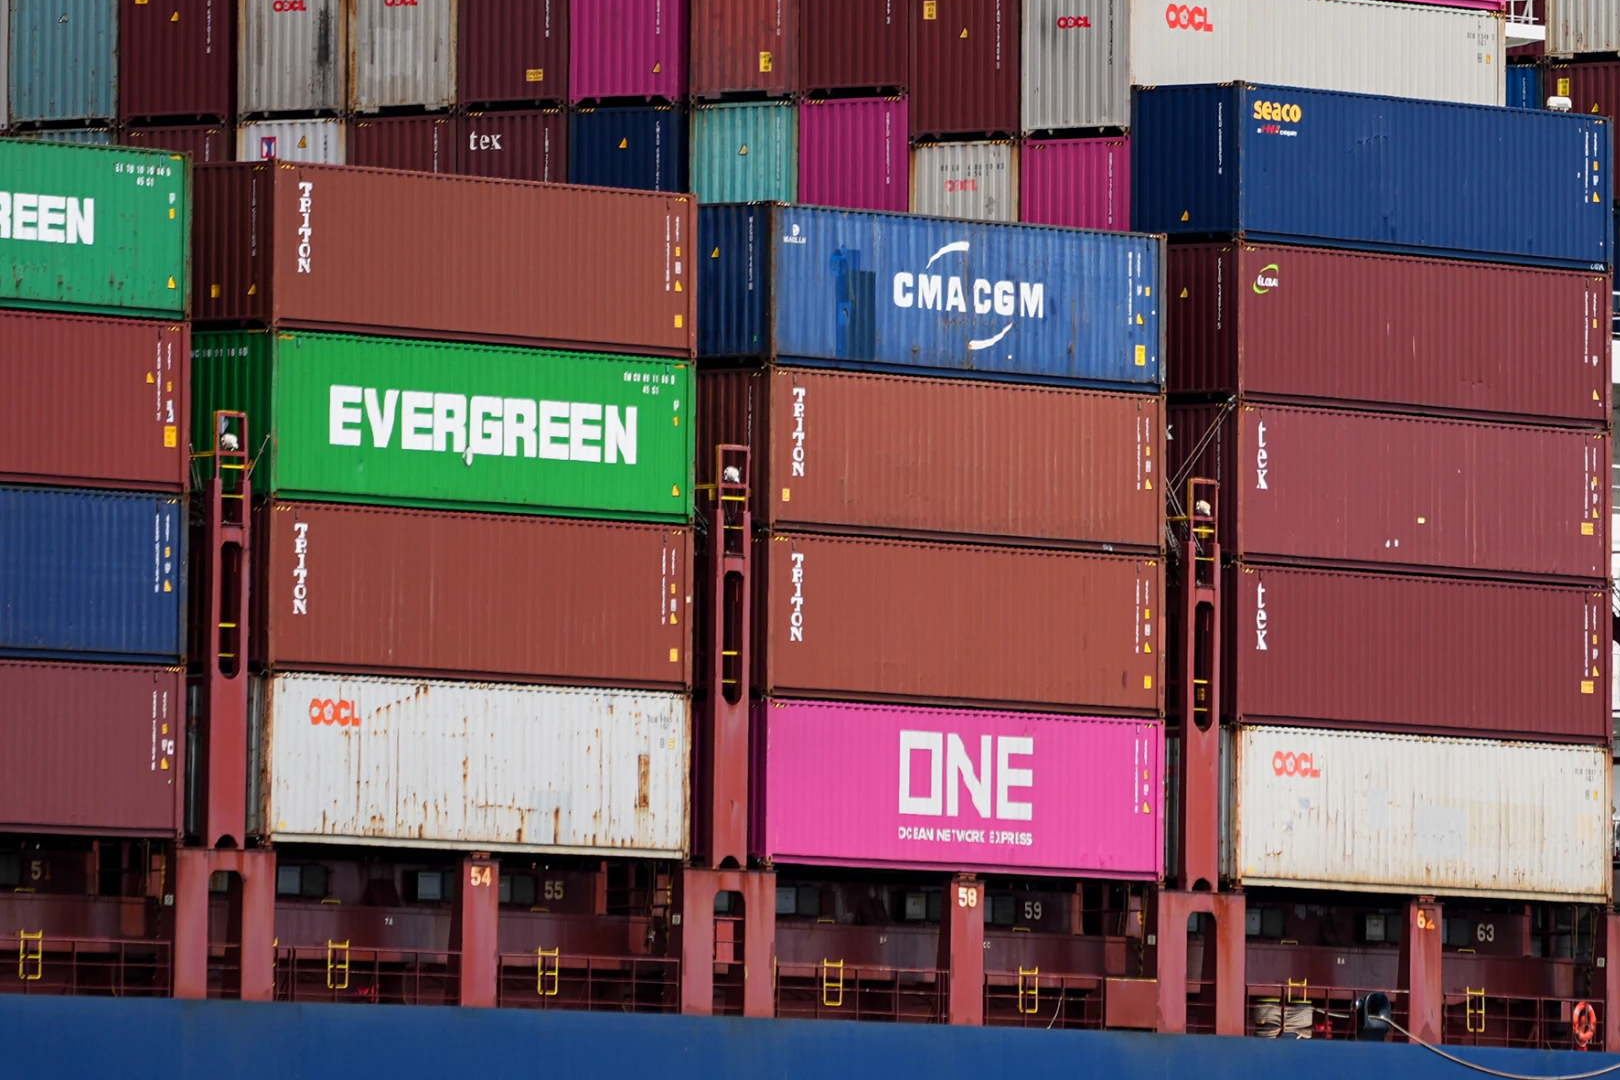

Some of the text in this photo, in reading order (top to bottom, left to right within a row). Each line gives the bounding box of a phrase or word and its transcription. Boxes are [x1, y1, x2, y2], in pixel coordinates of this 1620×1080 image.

[273, 0, 307, 13] OOCL
[1165, 3, 1214, 33] OOCL
[1057, 16, 1091, 29] OOCL
[1254, 100, 1302, 123] seaco
[469, 131, 502, 151] tex
[297, 181, 313, 274] TRITON
[893, 272, 1043, 318] CMA CGM
[330, 385, 637, 465] EVERGREEN
[792, 387, 806, 477] TRITON
[1256, 421, 1268, 490] tex
[292, 522, 309, 615] TRITON
[790, 552, 804, 642] TRITON
[1256, 582, 1268, 651] tex
[309, 698, 361, 727] OOCL
[899, 730, 1033, 820] ONE
[1272, 750, 1320, 778] OOCL
[898, 826, 1033, 846] OCEAN NETWORK EXPRESS
[470, 866, 492, 886] 54
[544, 880, 564, 900] 55
[958, 886, 978, 907] 58
[1024, 901, 1042, 920] 59
[1477, 924, 1495, 942] 63
